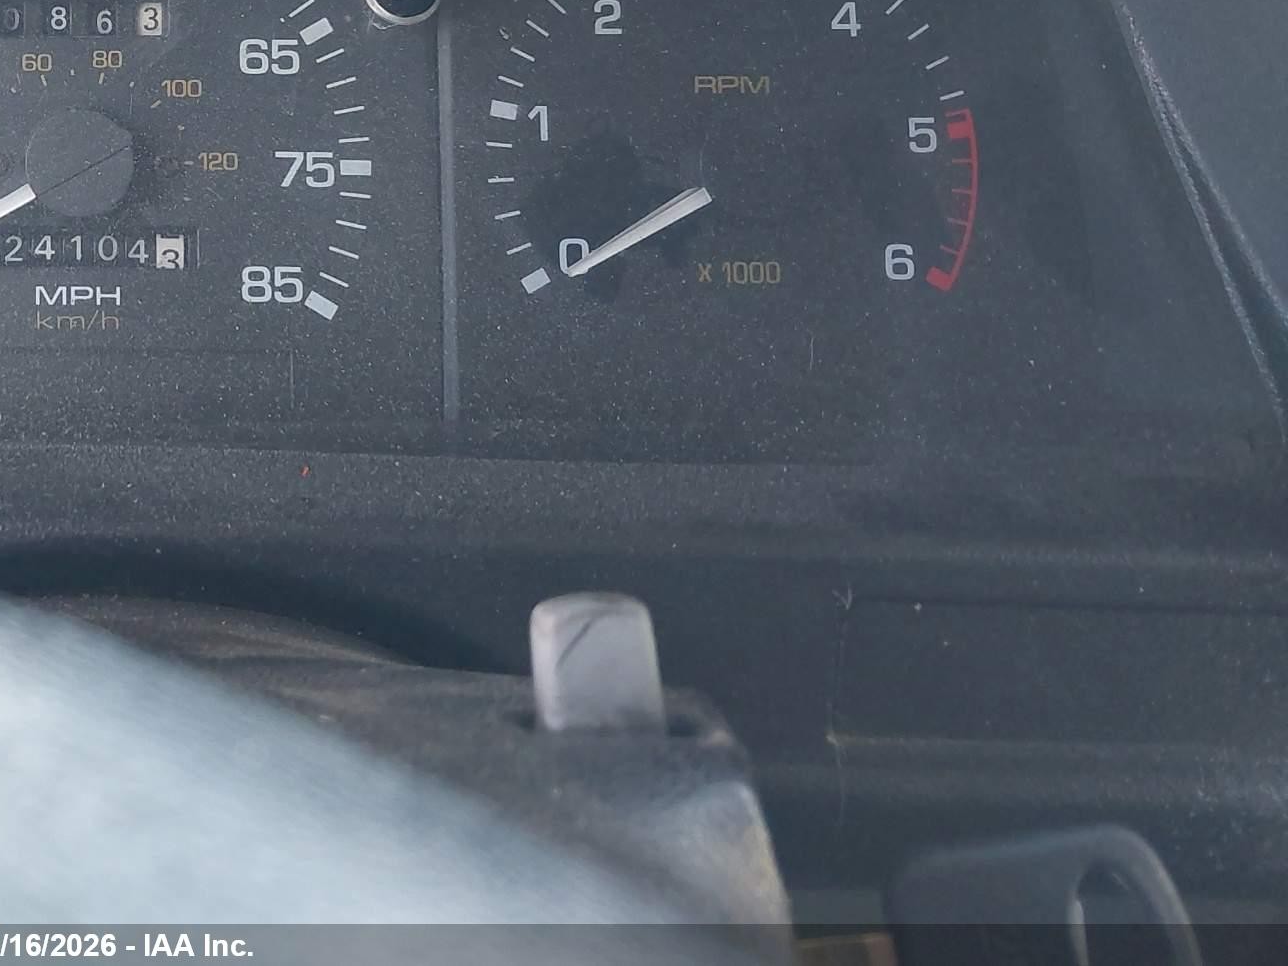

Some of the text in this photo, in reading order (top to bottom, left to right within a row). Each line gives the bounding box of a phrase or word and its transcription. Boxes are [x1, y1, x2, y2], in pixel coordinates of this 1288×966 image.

[593, 0, 622, 35] 2
[831, 1, 861, 37] 4
[22, 52, 52, 72] 60
[92, 50, 123, 70] 80
[238, 40, 300, 75] 65
[161, 79, 202, 98] 100
[694, 75, 770, 95] RPM
[527, 105, 549, 142] 1
[908, 116, 938, 153] 5
[198, 152, 239, 172] 120
[274, 151, 334, 187] 75
[559, 238, 589, 276] 0
[721, 262, 781, 285] 1000
[884, 244, 914, 280] 6
[35, 286, 121, 306] MPH
[241, 266, 304, 302] 85
[35, 310, 119, 331] km/h
